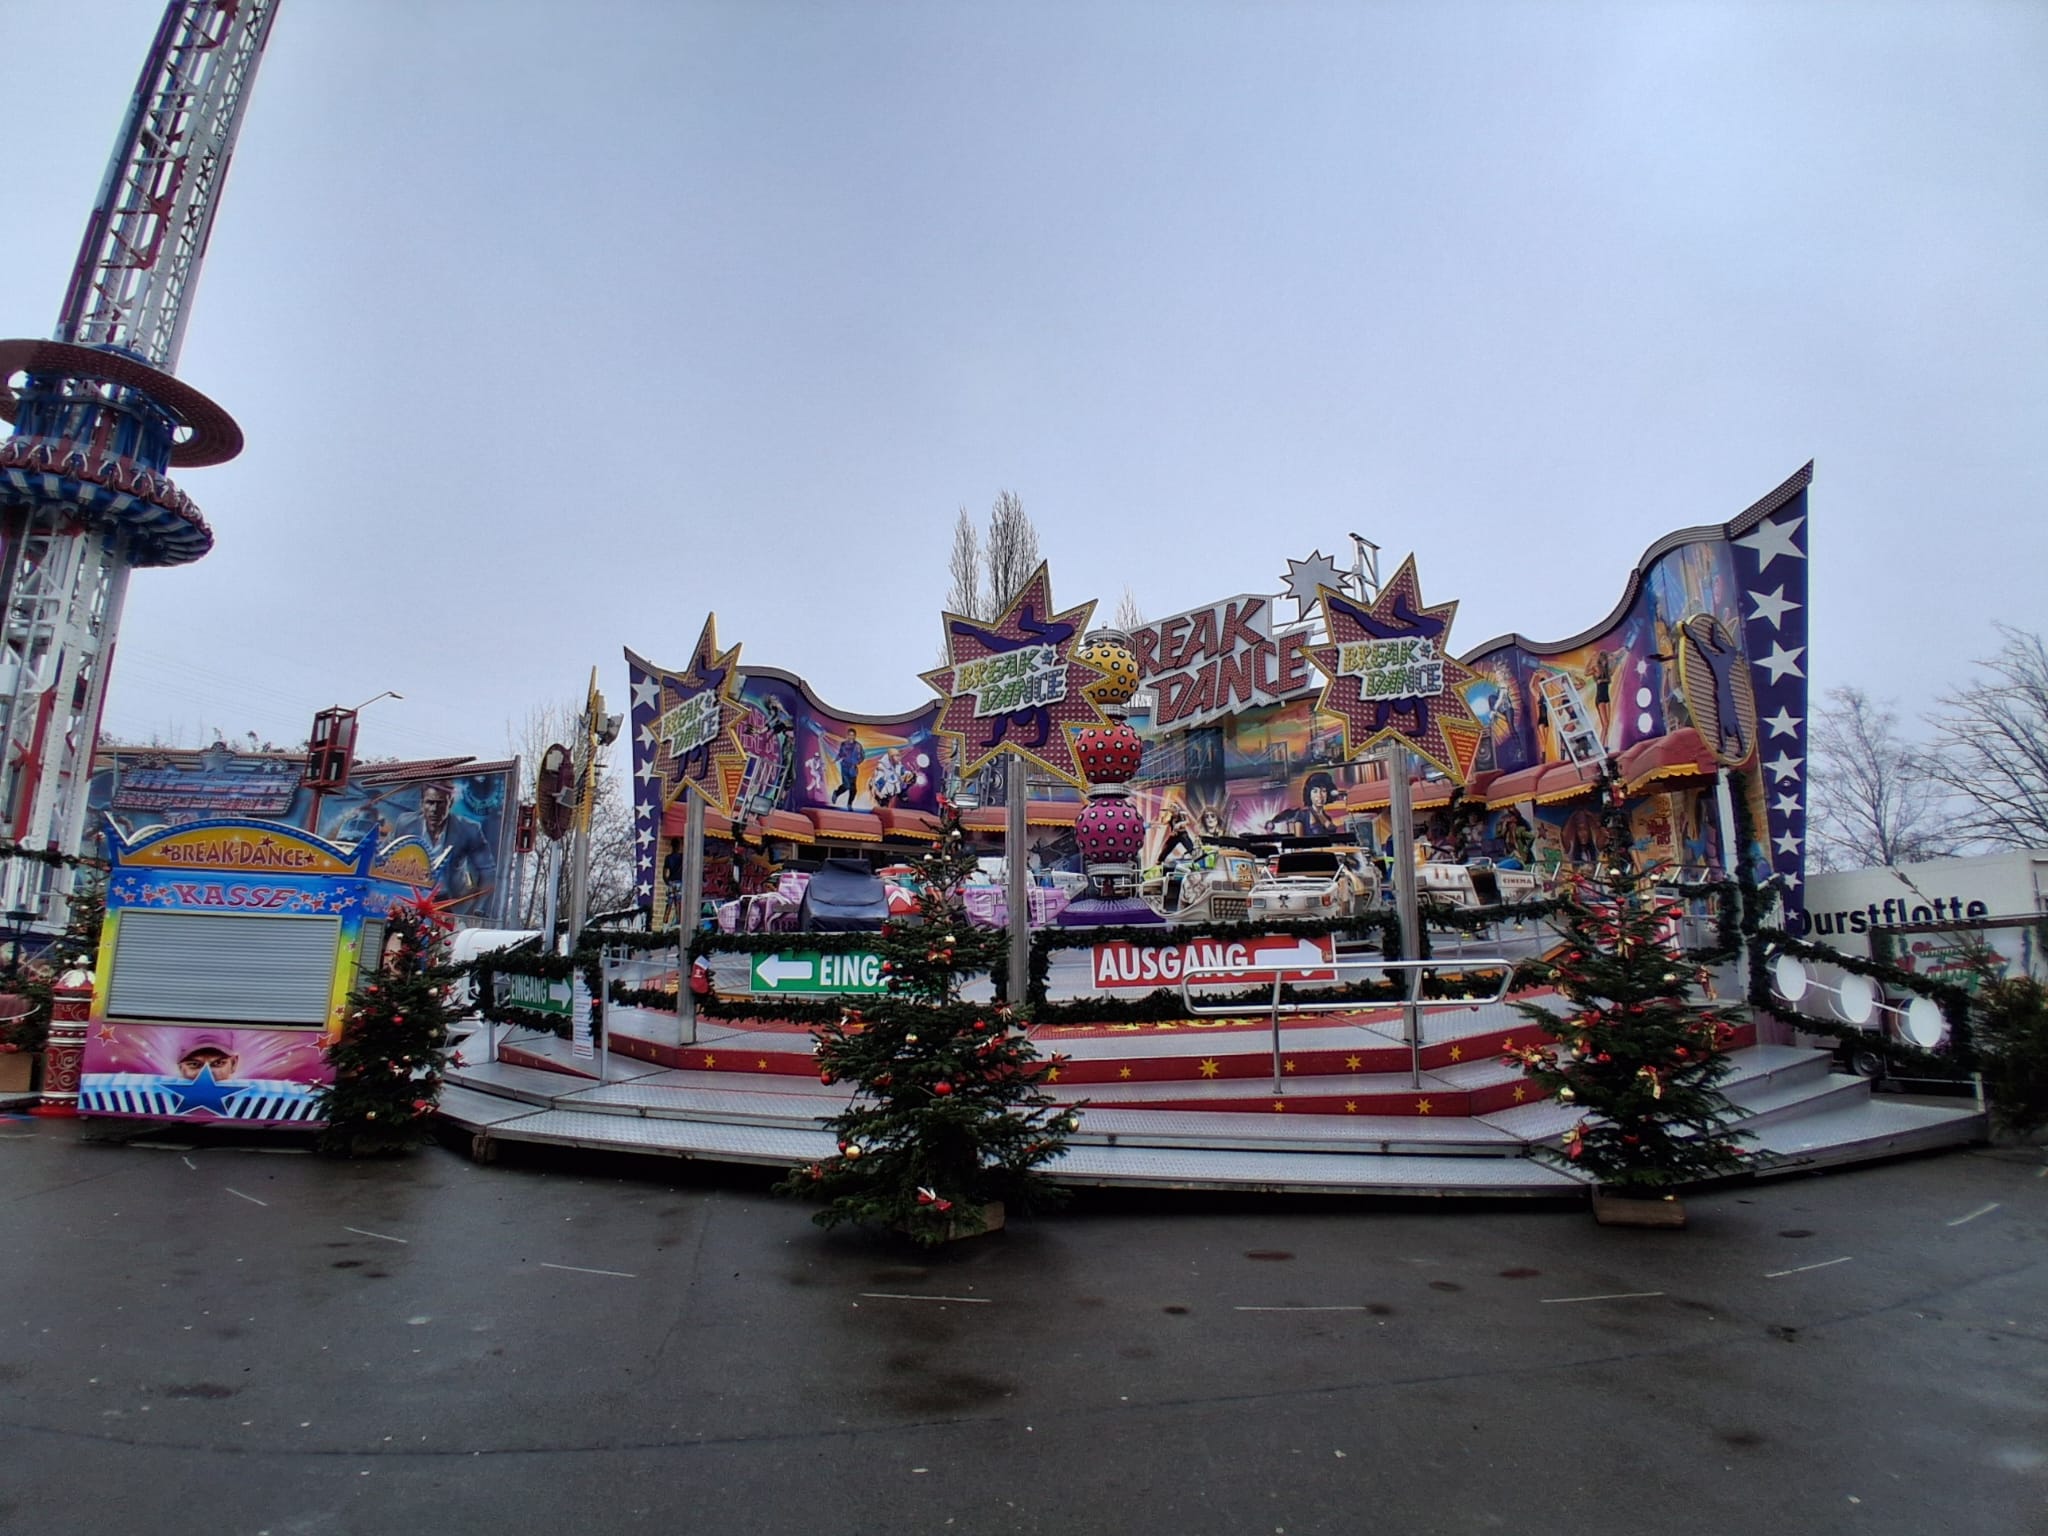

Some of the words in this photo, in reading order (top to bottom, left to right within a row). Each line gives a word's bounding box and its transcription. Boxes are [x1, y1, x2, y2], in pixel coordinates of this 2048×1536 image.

[1125, 597, 1266, 680] REAK
[1343, 640, 1420, 673] BREAK
[958, 648, 1041, 693] BREAK
[979, 667, 1065, 714] DANCE
[1146, 630, 1308, 726] DANCE
[1365, 662, 1443, 697] DANCE
[662, 693, 706, 740] BREAK
[672, 709, 718, 756] DANCE
[169, 840, 305, 867] BREAK-DANCE
[172, 883, 297, 909] KASSE
[1098, 943, 1249, 982] AUSGANG
[511, 975, 548, 1005] EINGANG
